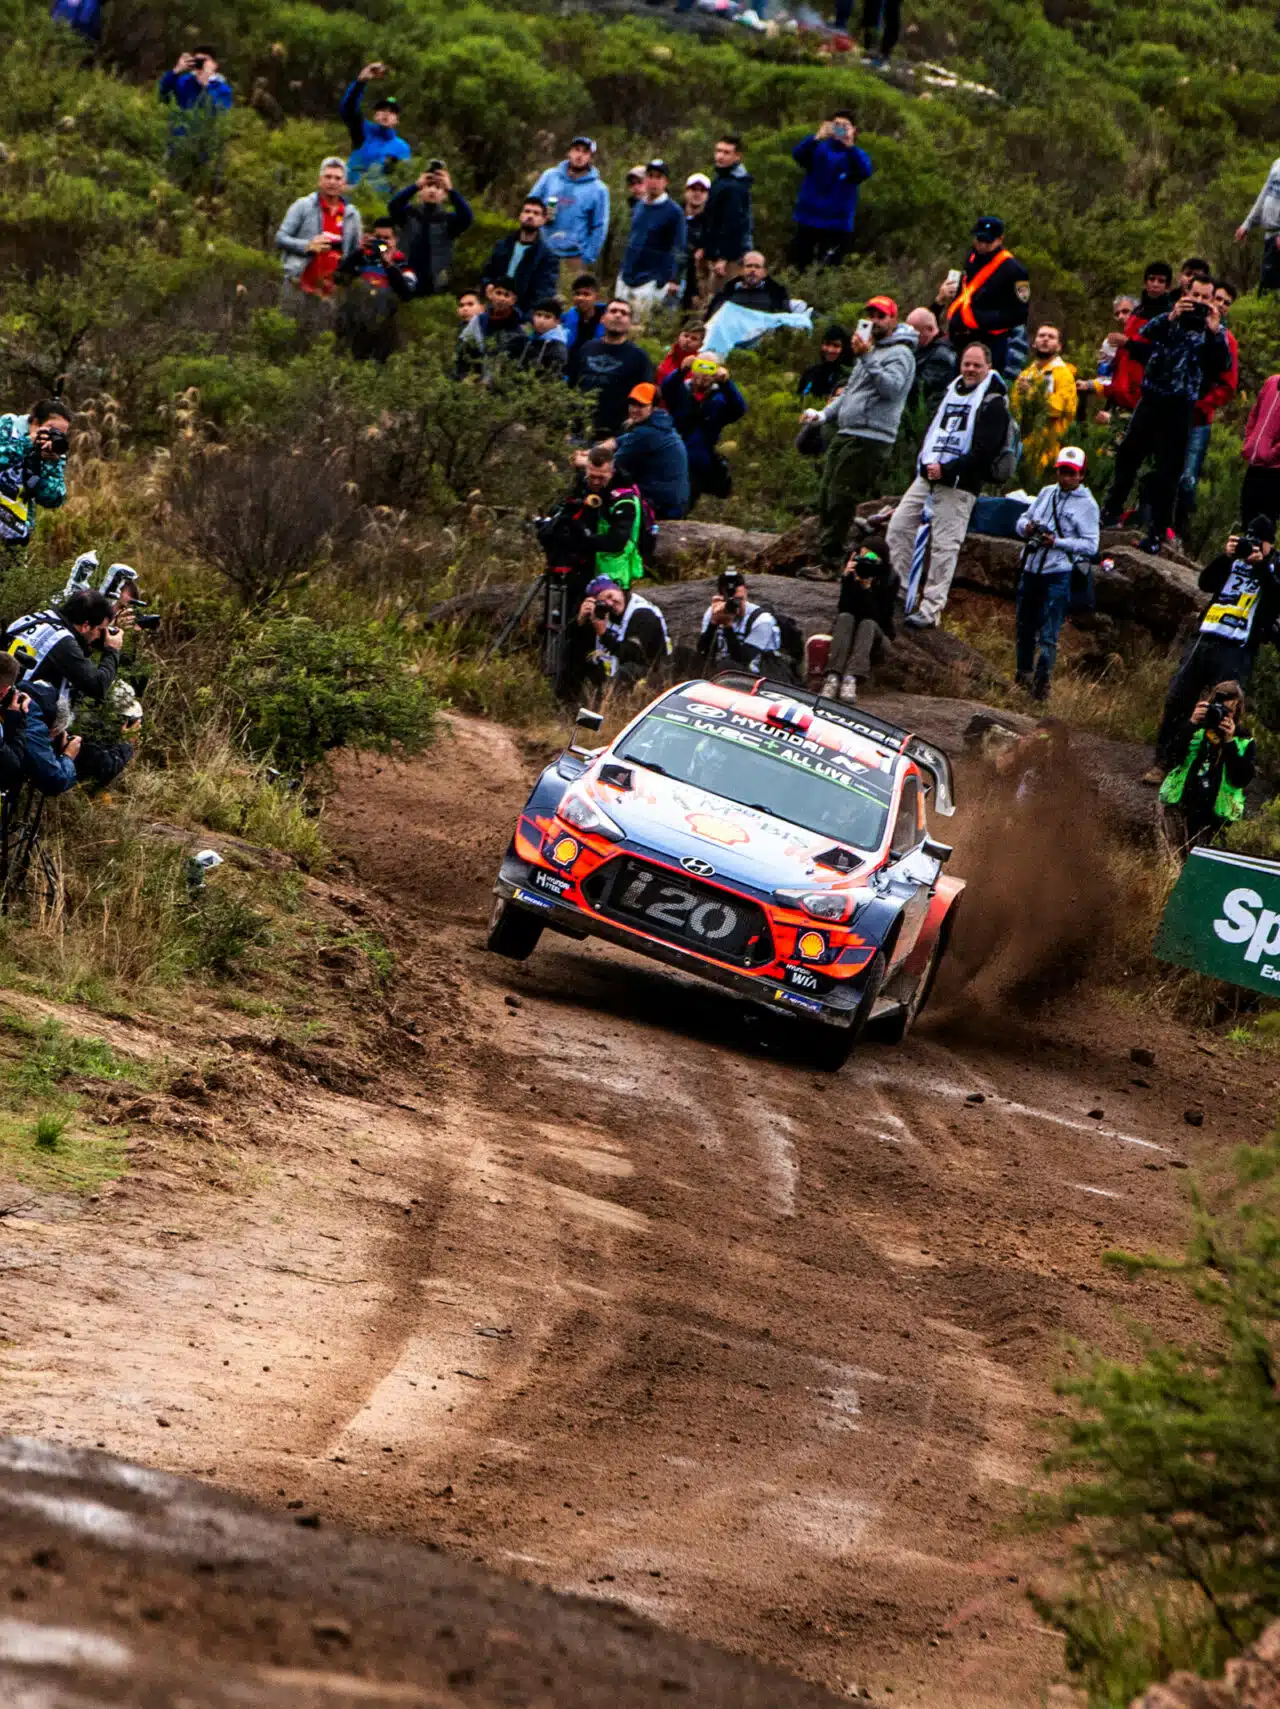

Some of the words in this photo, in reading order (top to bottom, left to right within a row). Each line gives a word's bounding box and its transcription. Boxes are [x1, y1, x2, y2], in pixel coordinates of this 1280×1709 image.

[731, 715, 825, 756] HYUNDAI
[780, 749, 812, 768] ALL
[815, 762, 853, 786] LIVE
[544, 883, 561, 894] STEEL
[623, 872, 738, 939] i20
